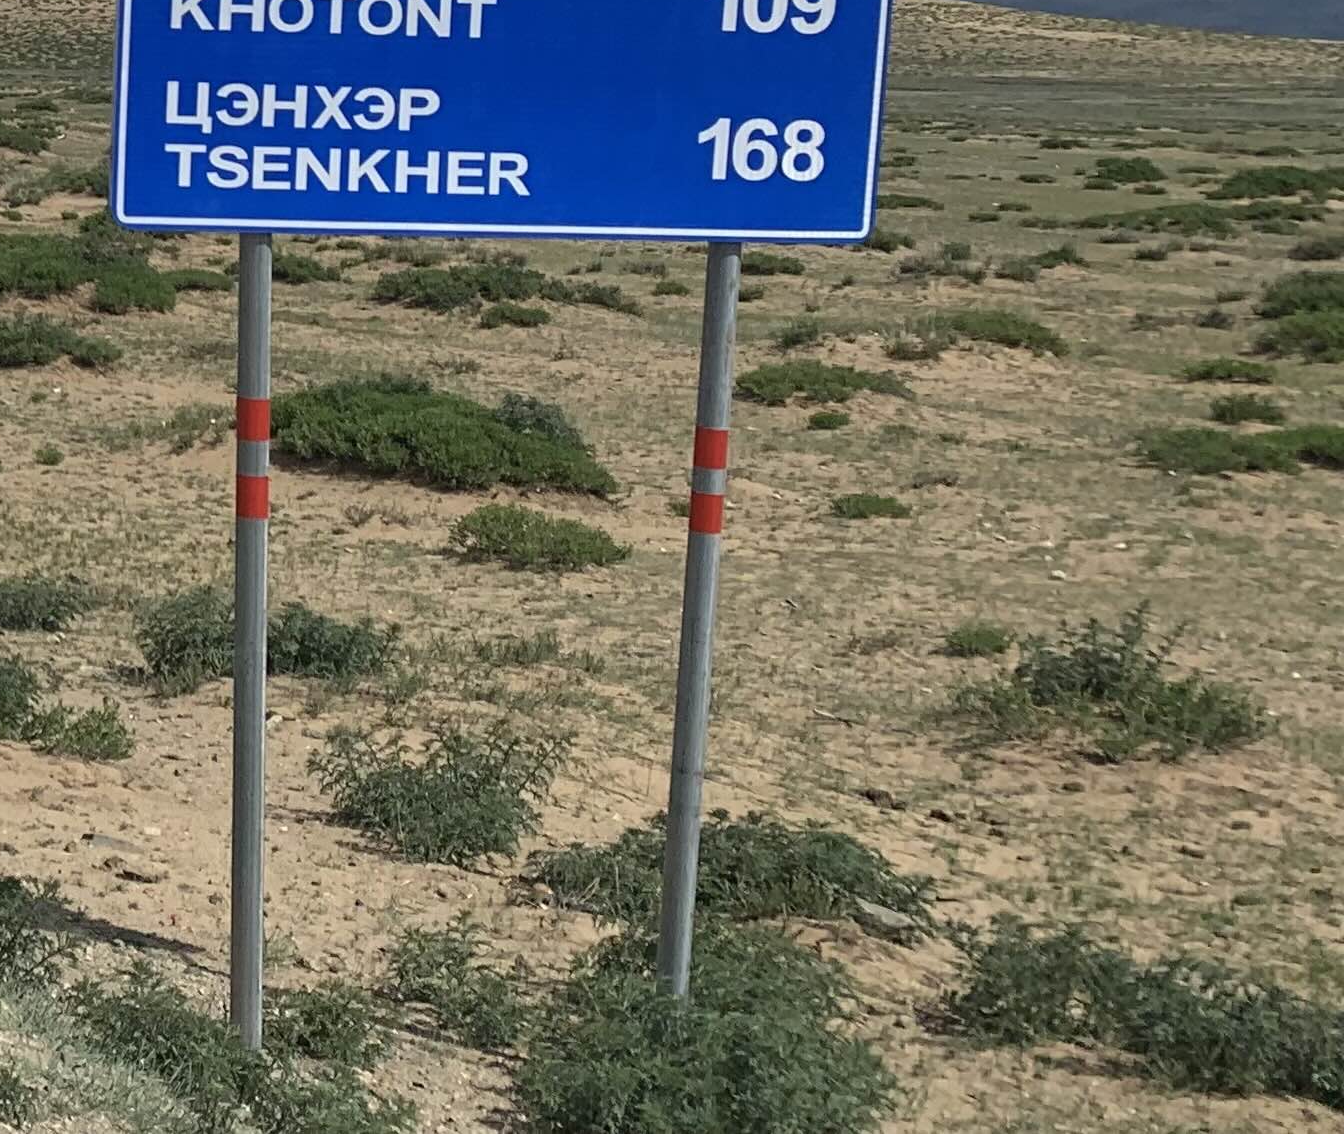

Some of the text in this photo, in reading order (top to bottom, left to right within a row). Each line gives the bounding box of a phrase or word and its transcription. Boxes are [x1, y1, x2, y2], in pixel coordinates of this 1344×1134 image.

[166, 81, 440, 134] ЦЭНХЭР
[164, 143, 530, 196] TSENKHER
[698, 117, 825, 182] 168
